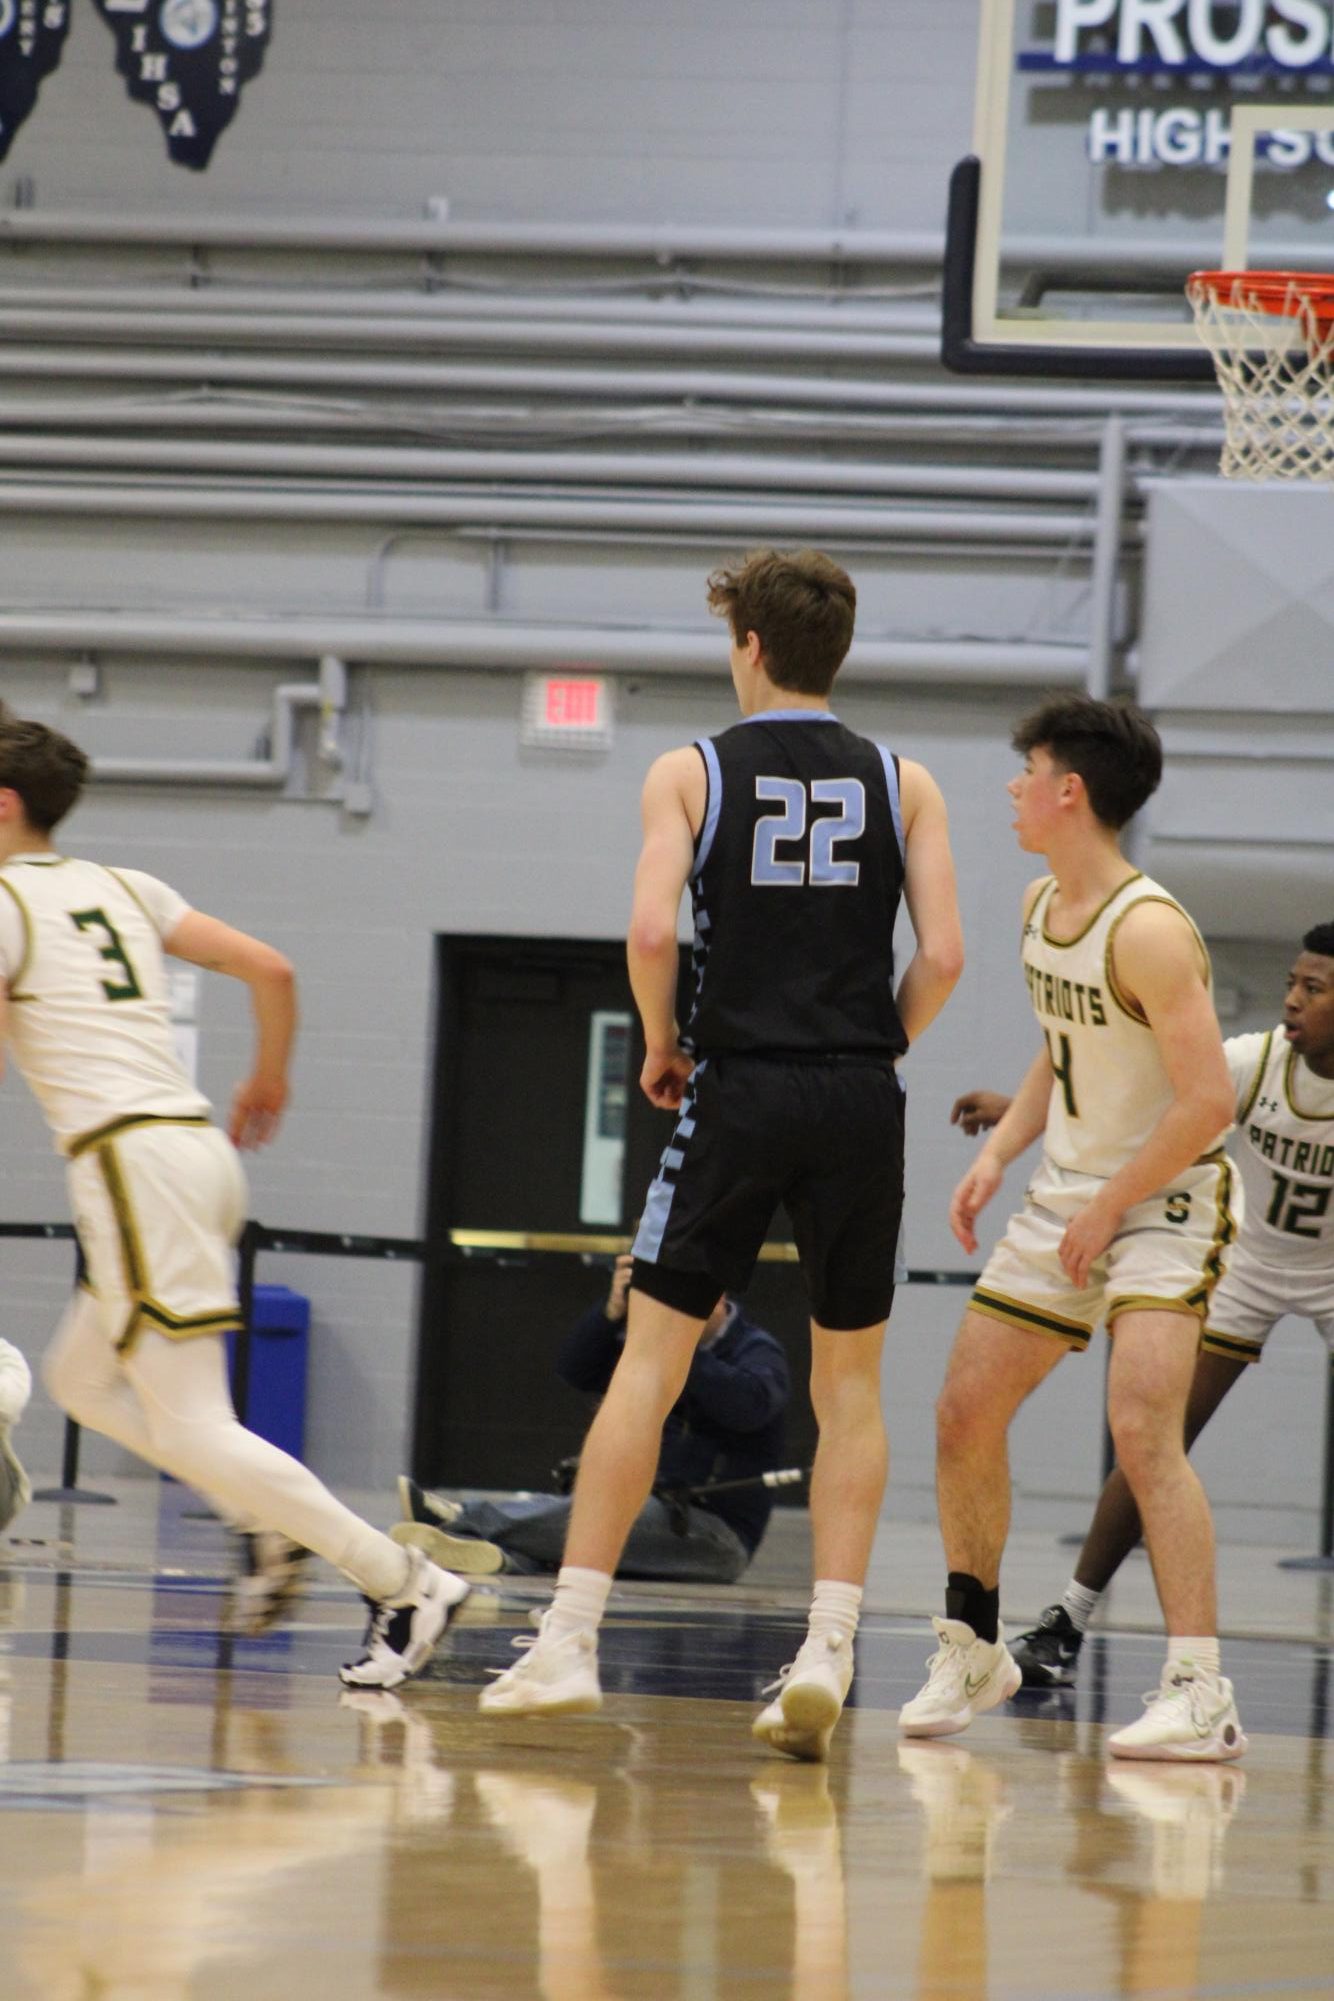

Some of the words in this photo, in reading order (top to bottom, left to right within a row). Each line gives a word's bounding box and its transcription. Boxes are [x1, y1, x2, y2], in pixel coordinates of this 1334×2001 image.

[1053, 0, 1334, 67] PROS
[750, 775, 867, 887] 22
[68, 906, 144, 1002] 3
[1043, 1026, 1080, 1119] 4
[1164, 1190, 1192, 1225] S
[1266, 1169, 1333, 1239] 12
